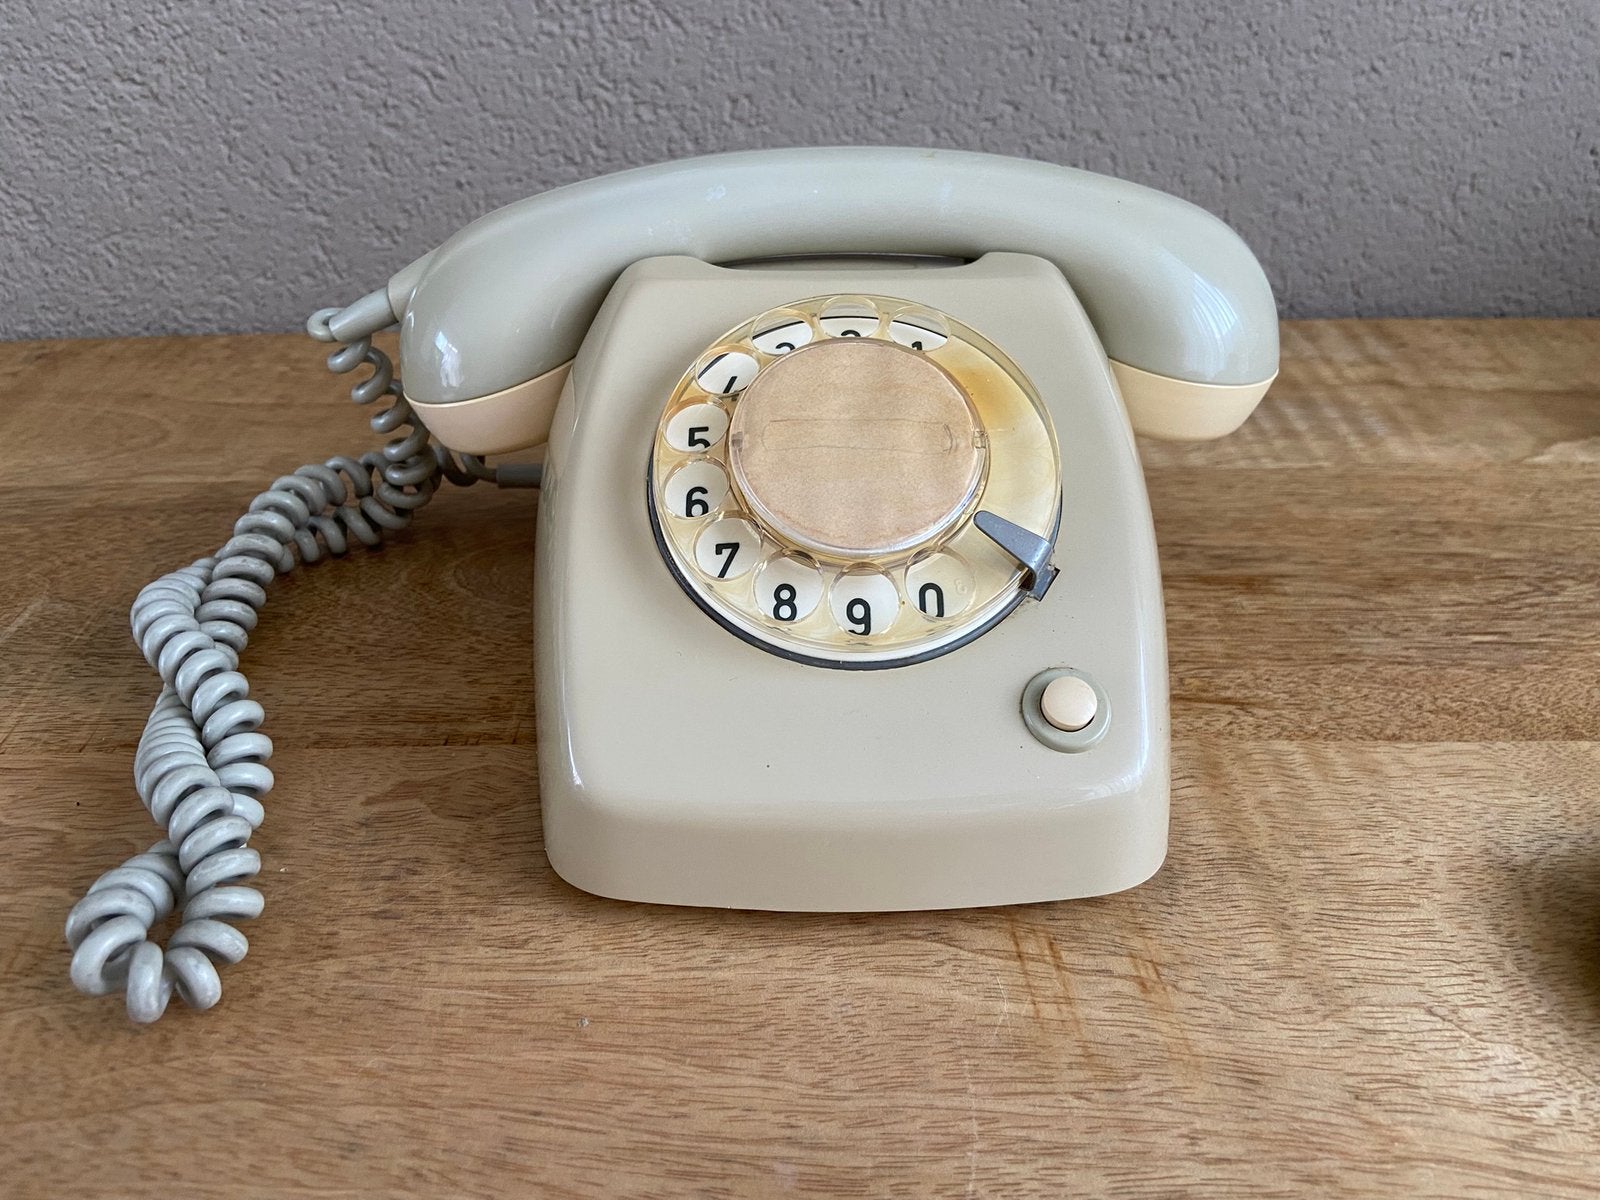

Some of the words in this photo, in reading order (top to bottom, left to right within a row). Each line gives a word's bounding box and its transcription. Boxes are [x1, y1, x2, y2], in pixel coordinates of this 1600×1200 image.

[688, 426, 711, 449] 5
[685, 487, 709, 517] 6
[715, 541, 741, 579] 7
[772, 583, 798, 622] 8
[846, 597, 872, 636] 9
